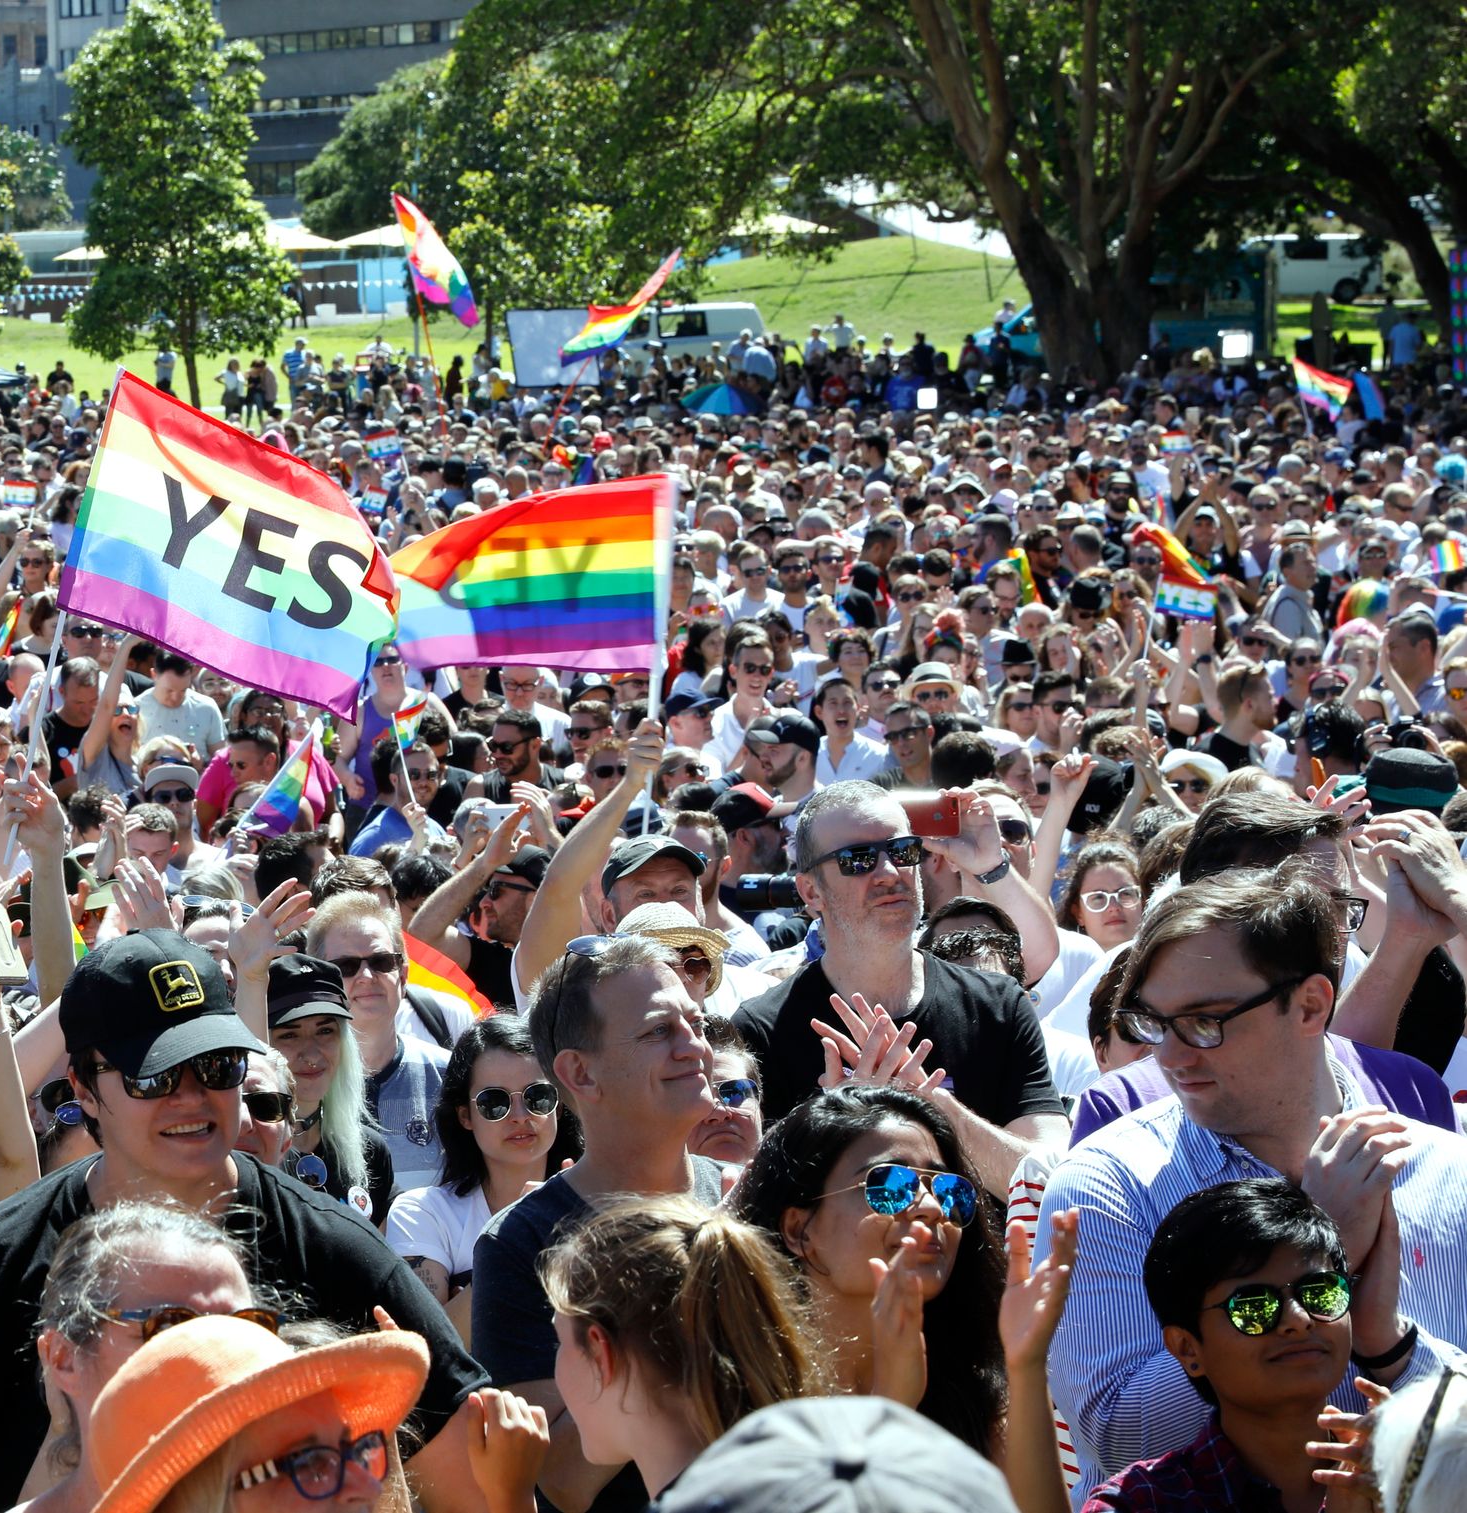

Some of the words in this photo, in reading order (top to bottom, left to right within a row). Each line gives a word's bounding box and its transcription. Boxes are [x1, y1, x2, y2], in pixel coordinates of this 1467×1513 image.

[365, 435, 401, 455] YES
[161, 471, 370, 630] YES
[1162, 582, 1215, 614] YES
[181, 991, 200, 1001] DEERE
